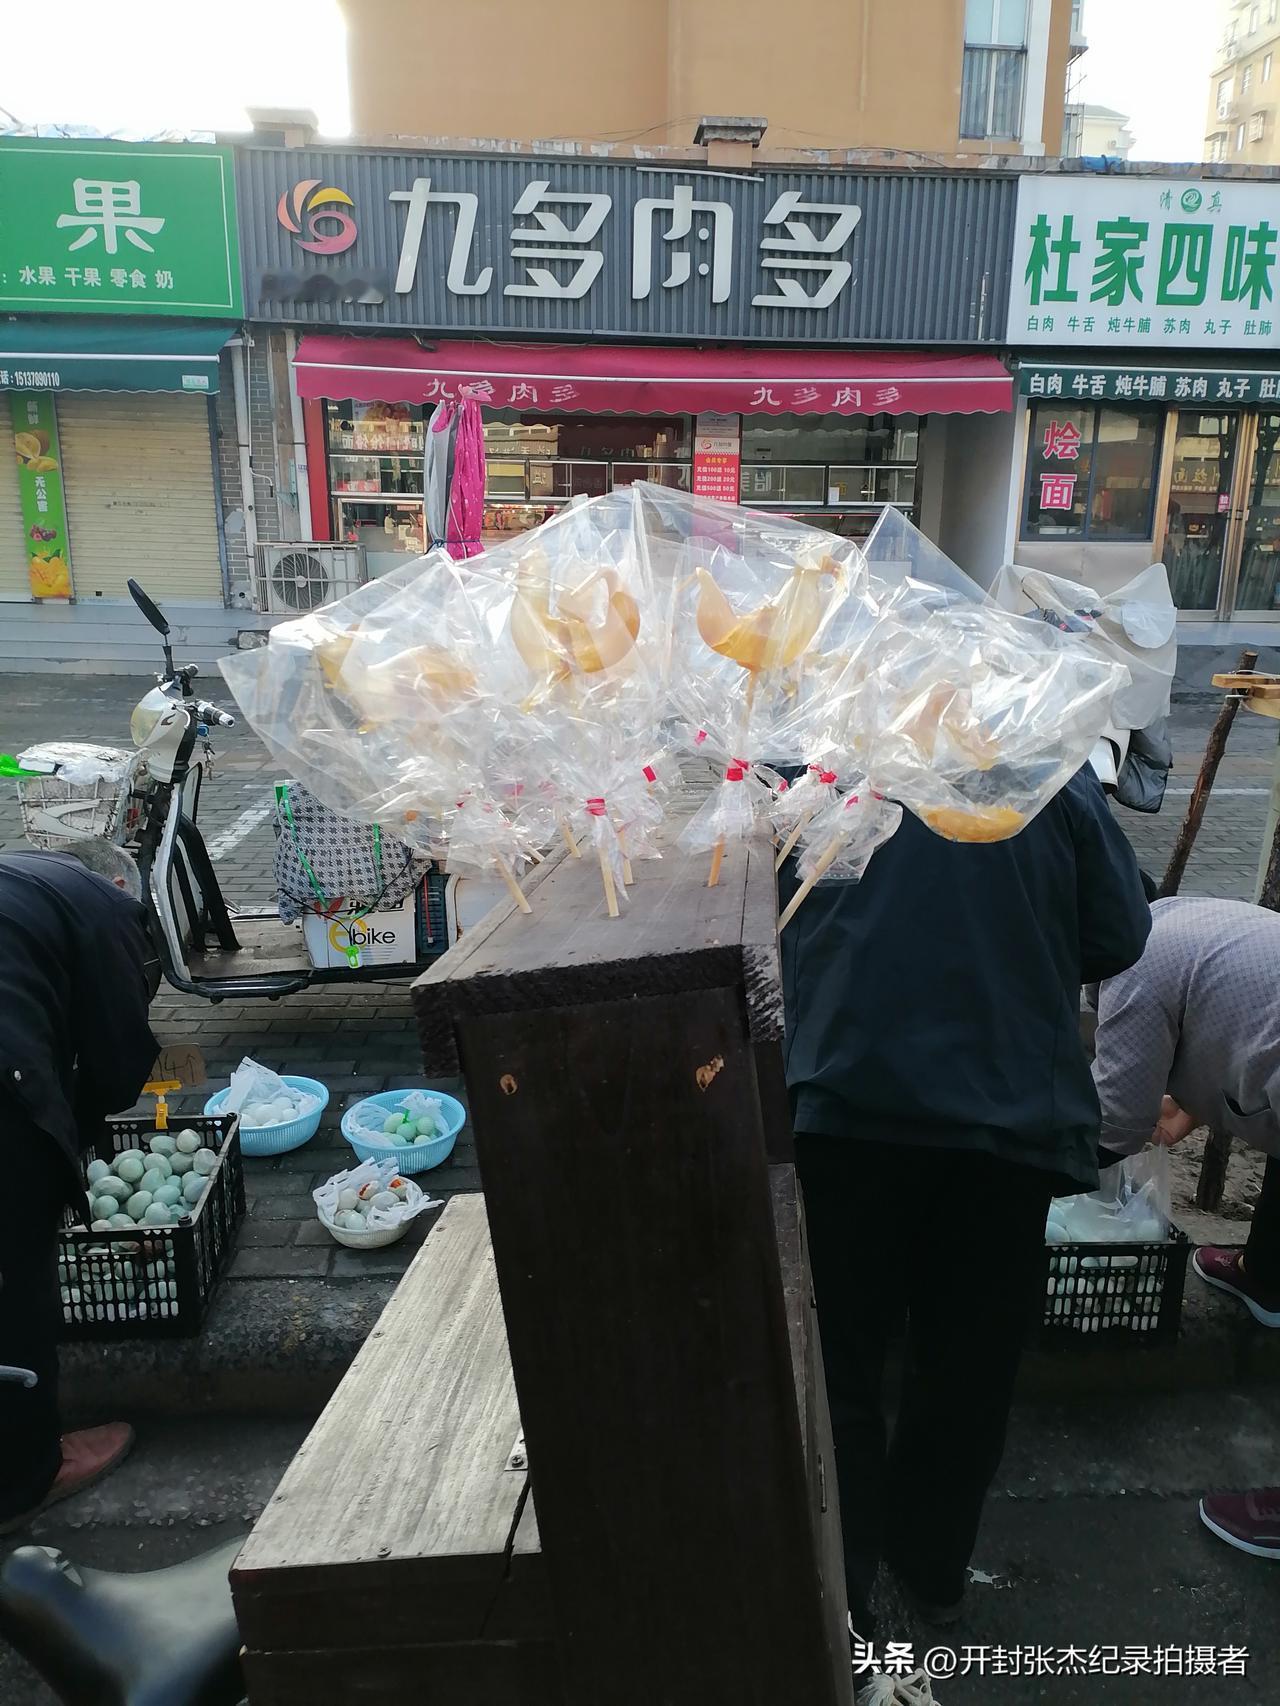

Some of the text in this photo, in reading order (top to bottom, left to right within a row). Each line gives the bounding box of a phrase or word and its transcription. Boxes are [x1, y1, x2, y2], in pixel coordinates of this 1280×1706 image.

[1159, 189, 1223, 213] 清真
[56, 178, 165, 254] 果
[388, 177, 862, 309] 九多肉多
[1024, 214, 1279, 310] 杜家四味
[19, 265, 174, 289] 水果 干果 零食 奶
[1027, 315, 1054, 332] 白肉
[1067, 316, 1096, 333] 牛舌
[1163, 318, 1191, 335] 苏肉
[1204, 318, 1232, 335] 丸子
[1244, 319, 1273, 336] 肚肺
[750, 386, 903, 407] 九多肉多
[1029, 373, 1063, 394] 白肉
[1072, 374, 1107, 396] 牛舌
[1175, 376, 1208, 398] 苏肉
[1216, 377, 1251, 398] 丸子
[1258, 378, 1280, 399] 肚
[1039, 420, 1081, 510] 烩面
